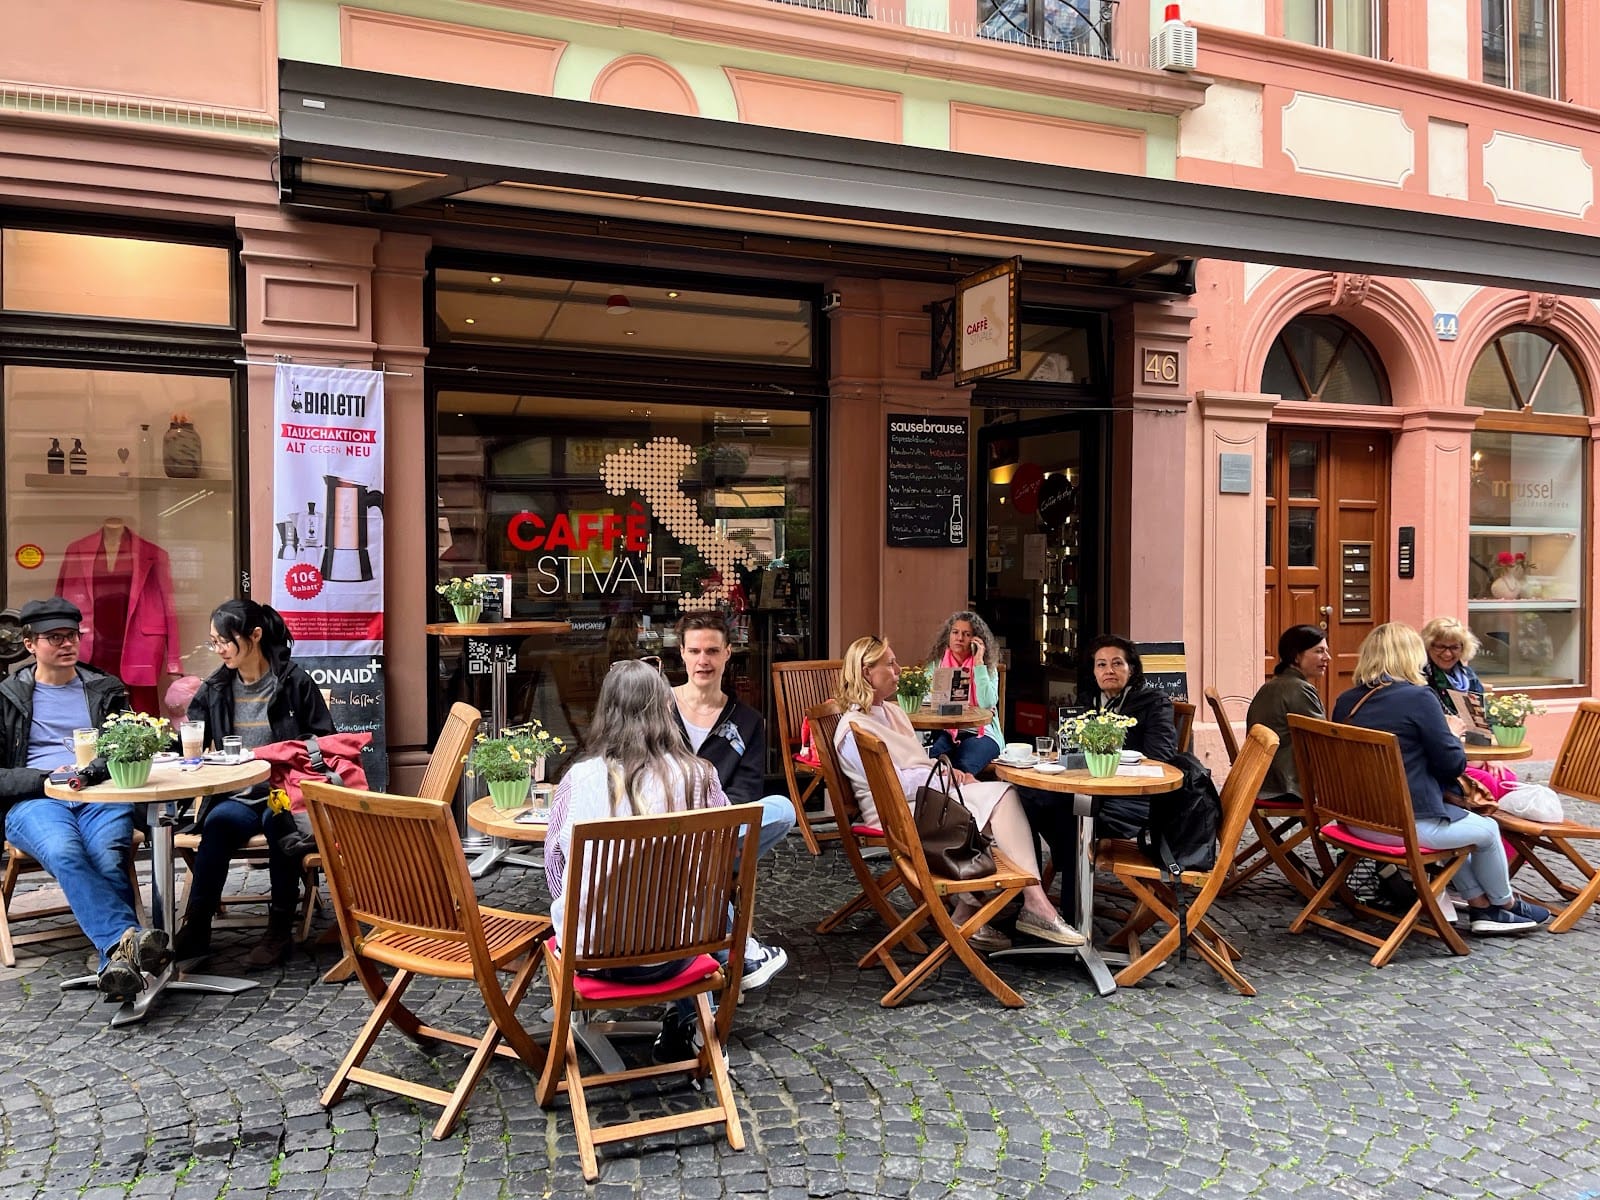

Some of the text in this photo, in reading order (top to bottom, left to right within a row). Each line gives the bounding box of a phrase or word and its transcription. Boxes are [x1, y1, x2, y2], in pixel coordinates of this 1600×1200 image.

[966, 316, 988, 335] CAFFÈ
[1435, 317, 1457, 336] 44
[1145, 353, 1177, 380] 46
[286, 426, 371, 442] TAUSCHAKTION
[286, 442, 371, 457] ALT GEGEN NEU
[507, 501, 648, 551] CAFFÈ
[291, 570, 318, 584] 10€
[537, 556, 682, 594] STIVALE
